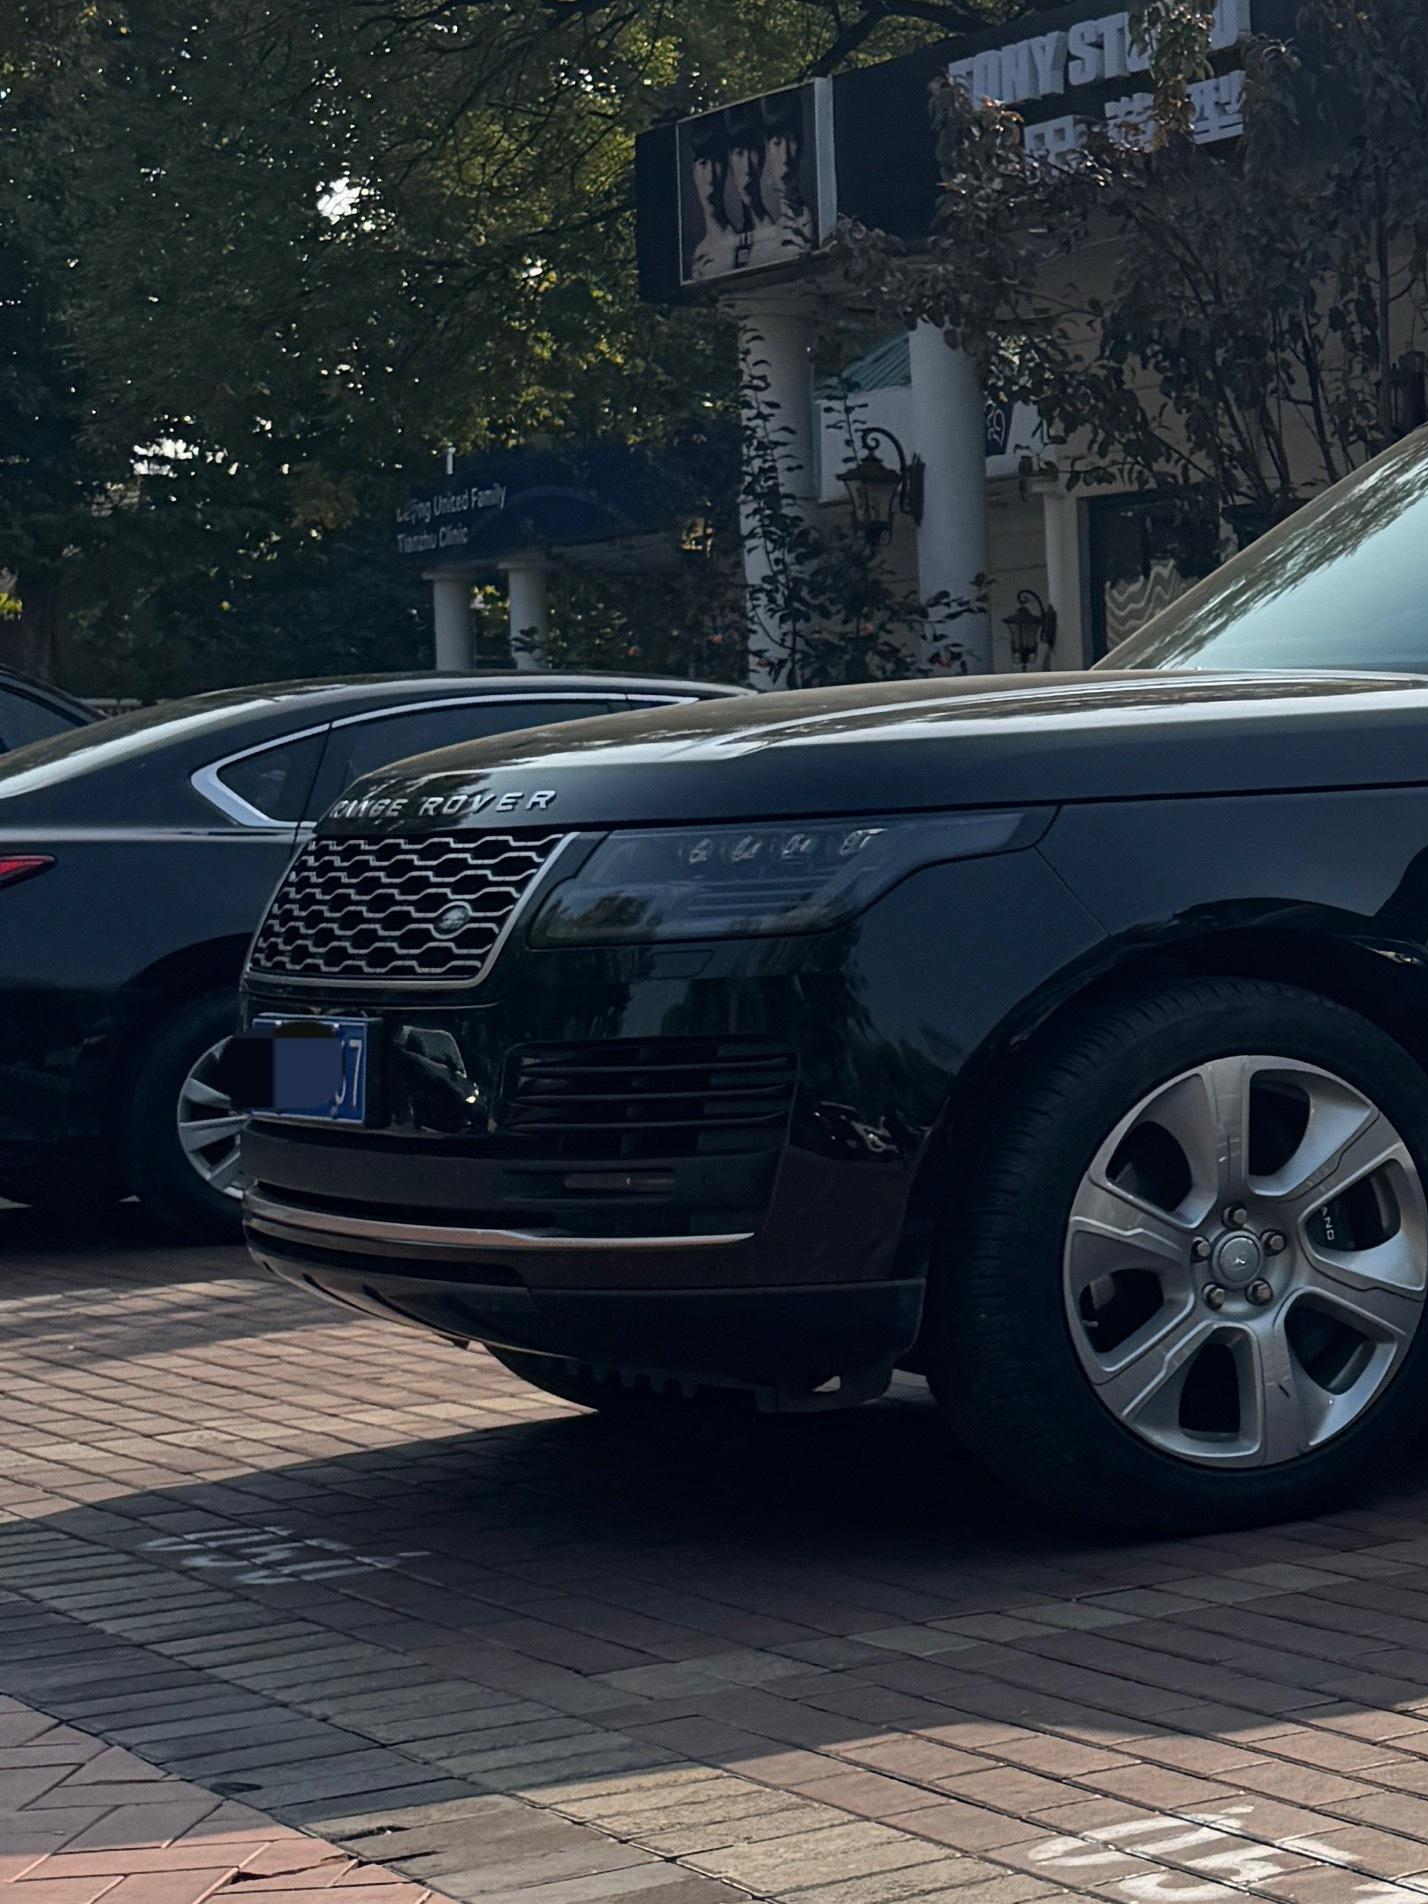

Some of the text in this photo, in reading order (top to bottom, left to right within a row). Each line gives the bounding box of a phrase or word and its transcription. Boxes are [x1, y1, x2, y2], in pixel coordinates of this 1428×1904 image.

[433, 489, 469, 516] United
[470, 483, 507, 510] Family
[418, 790, 557, 818] ROVER
